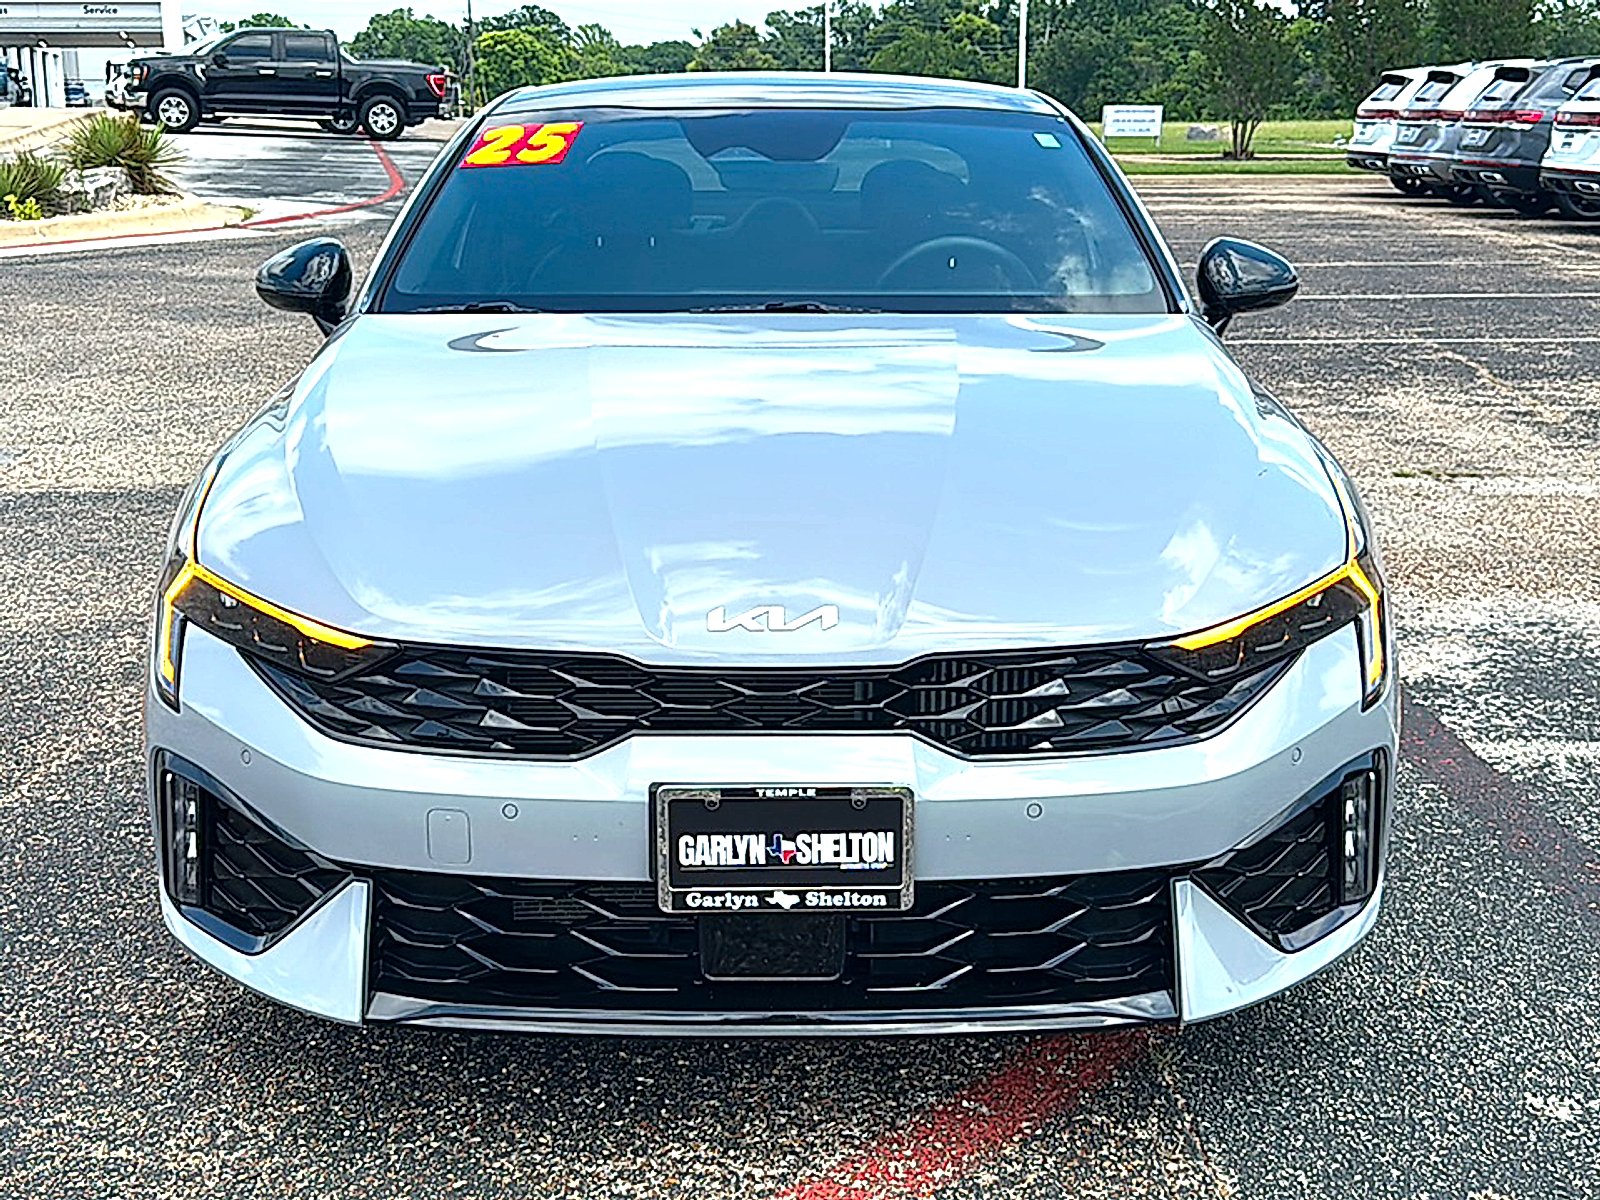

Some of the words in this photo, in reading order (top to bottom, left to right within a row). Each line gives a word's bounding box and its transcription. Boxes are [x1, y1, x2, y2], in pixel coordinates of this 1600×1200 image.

[83, 4, 118, 14] Service
[466, 123, 578, 164] 25
[706, 604, 839, 632] KIA
[755, 788, 817, 797] TEMPLE
[679, 834, 766, 866] GARLYN
[796, 831, 894, 864] SHELTON
[685, 892, 759, 910] Garlyn
[805, 891, 887, 906] Shelton
